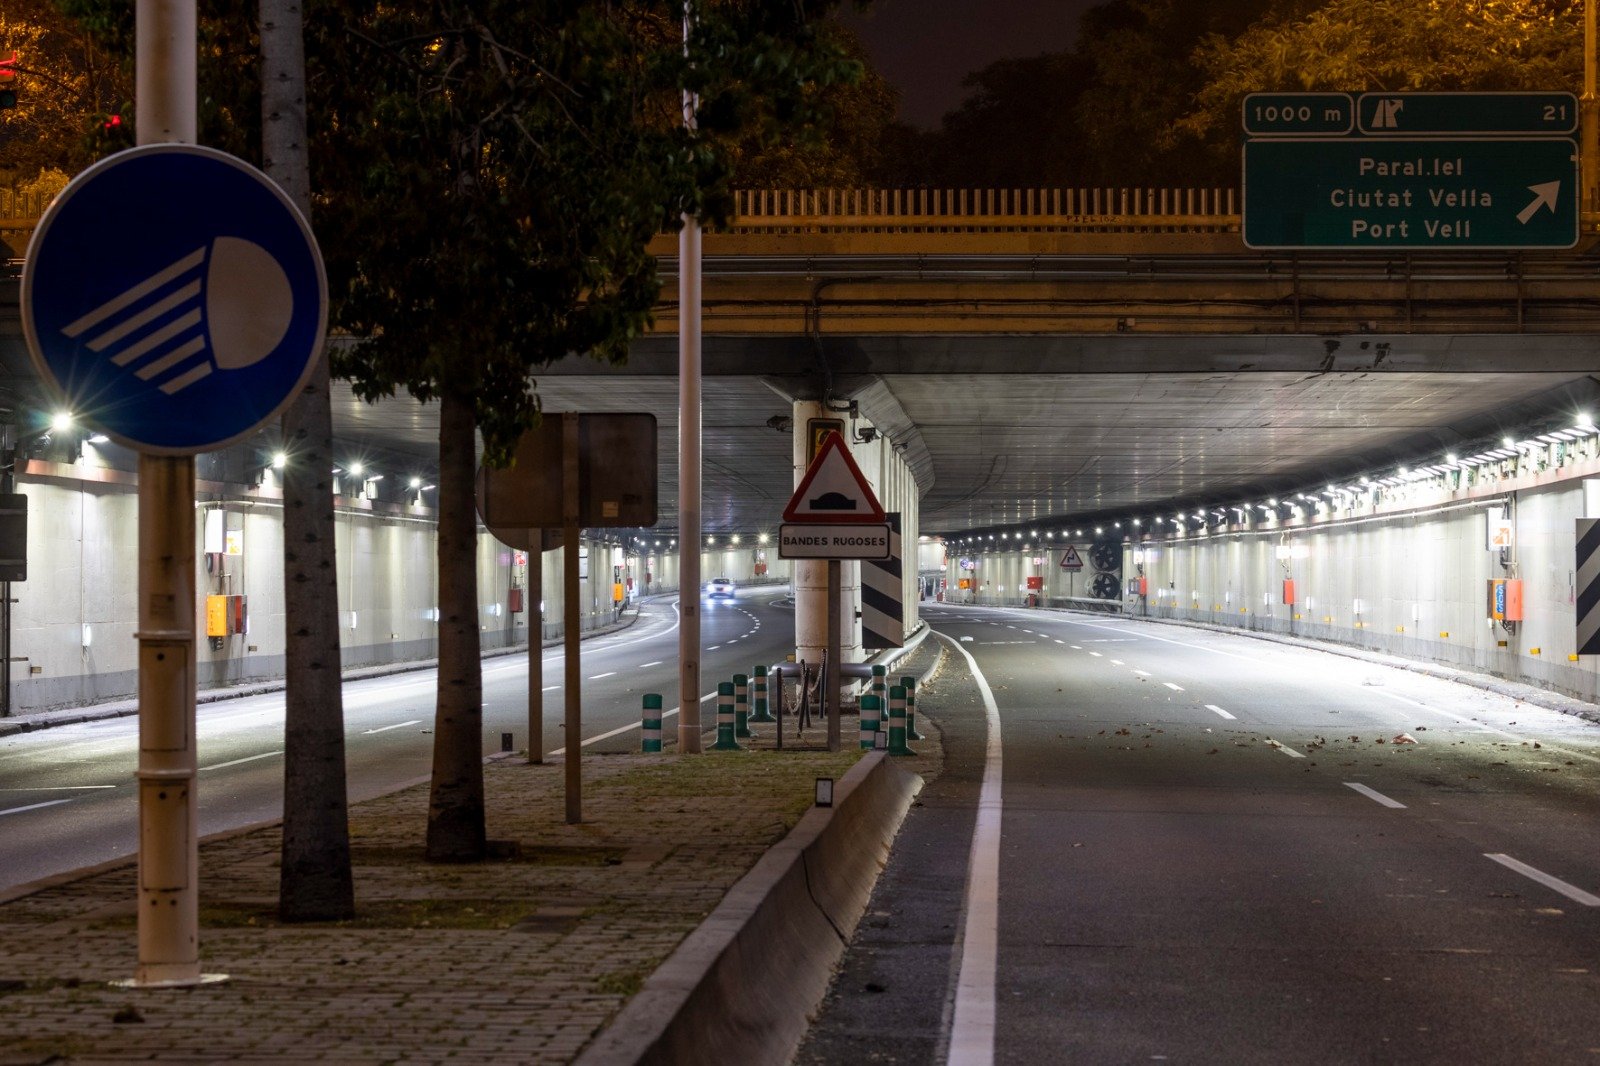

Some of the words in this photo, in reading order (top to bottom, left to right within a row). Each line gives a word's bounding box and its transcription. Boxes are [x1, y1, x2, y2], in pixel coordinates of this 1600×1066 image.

[1254, 106, 1311, 122] 1000
[1325, 109, 1341, 122] m
[1543, 105, 1566, 121] 21
[1359, 157, 1463, 176] Paral.lel
[1330, 188, 1412, 207] Ciutat
[1429, 188, 1492, 207] Vella
[1352, 219, 1409, 238] Port
[1424, 219, 1471, 238] Vell
[783, 537, 828, 546] BANDES
[833, 537, 886, 546] RUGOSES
